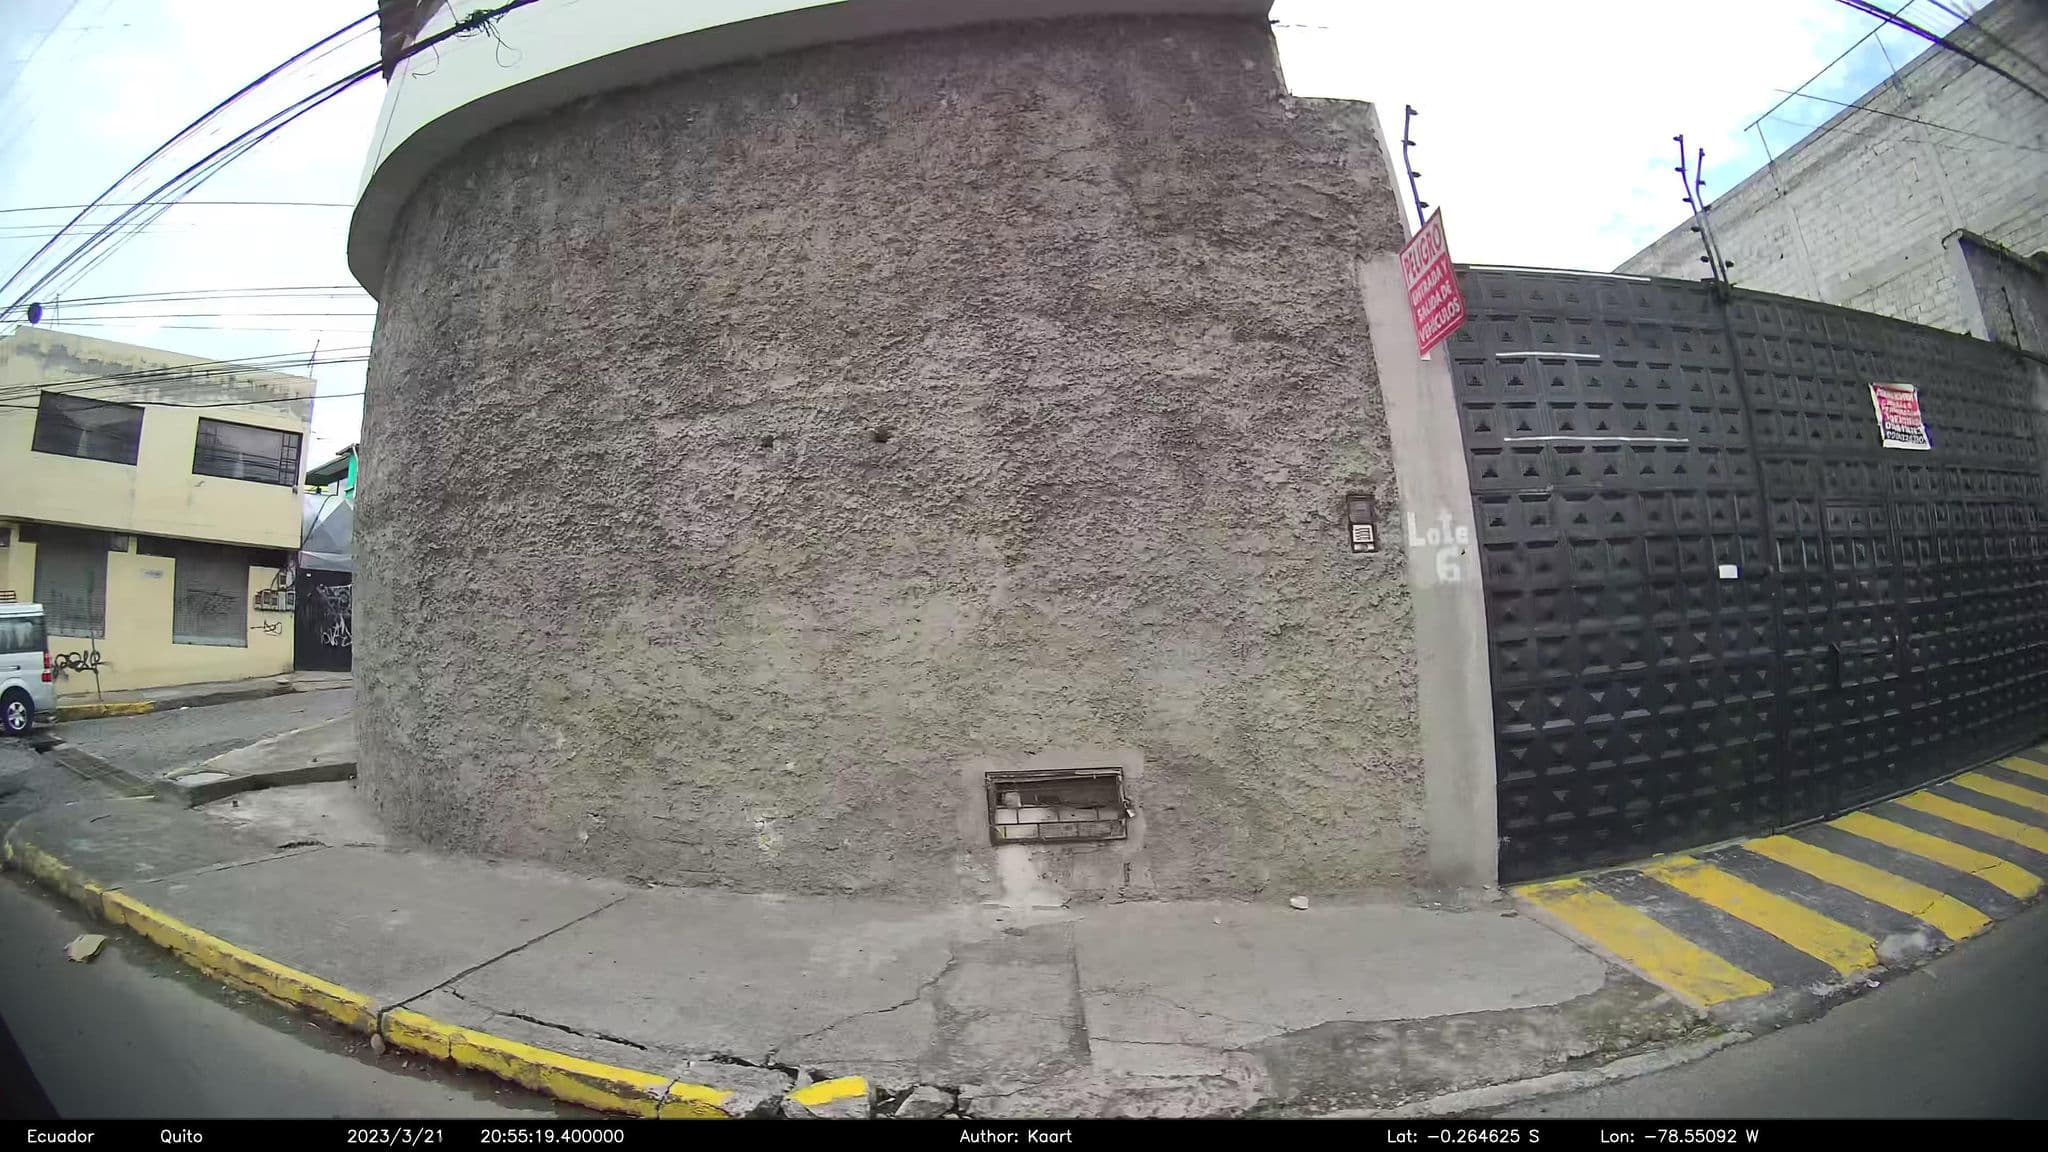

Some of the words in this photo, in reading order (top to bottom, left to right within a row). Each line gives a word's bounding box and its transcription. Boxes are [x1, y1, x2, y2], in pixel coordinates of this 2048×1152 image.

[1404, 223, 1442, 284] PELIGRO
[1411, 269, 1443, 306] ENTRADA
[1442, 260, 1449, 276] Y
[1416, 289, 1443, 322] SALIDA
[1441, 280, 1453, 297] DE
[1406, 509, 1469, 547] Lote
[1436, 545, 1461, 582] 6
